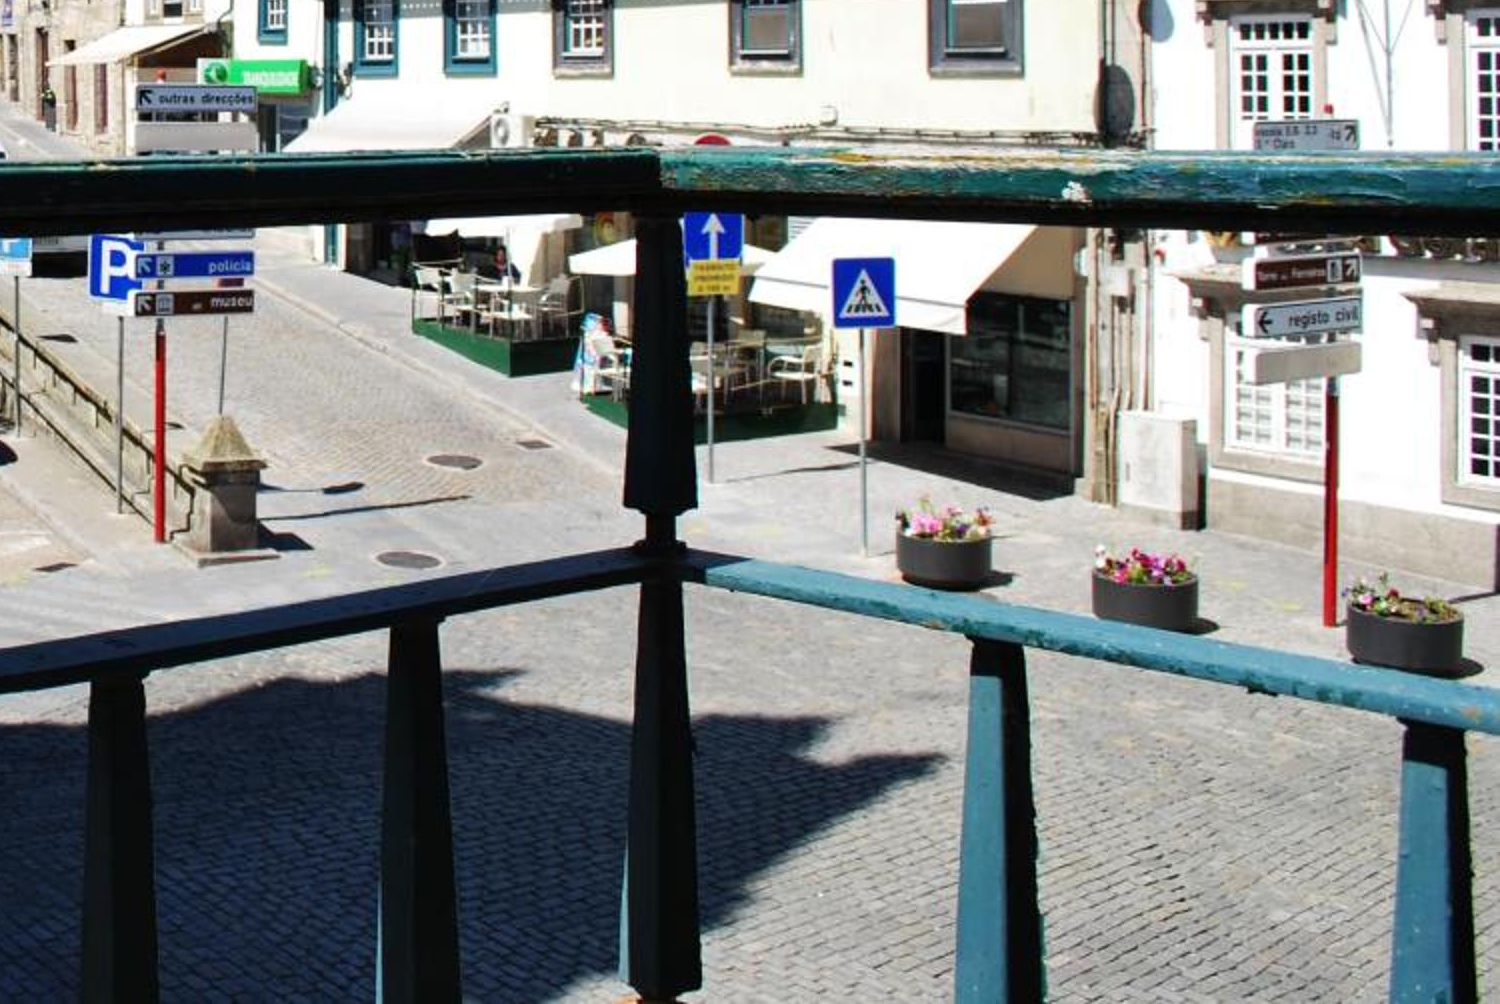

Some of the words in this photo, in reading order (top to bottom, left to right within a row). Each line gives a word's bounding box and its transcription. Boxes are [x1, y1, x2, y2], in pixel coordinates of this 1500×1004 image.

[158, 93, 195, 105] outras
[100, 239, 136, 295] P
[210, 296, 254, 308] museu
[1288, 309, 1330, 329] registo
[1335, 305, 1359, 323] civil
